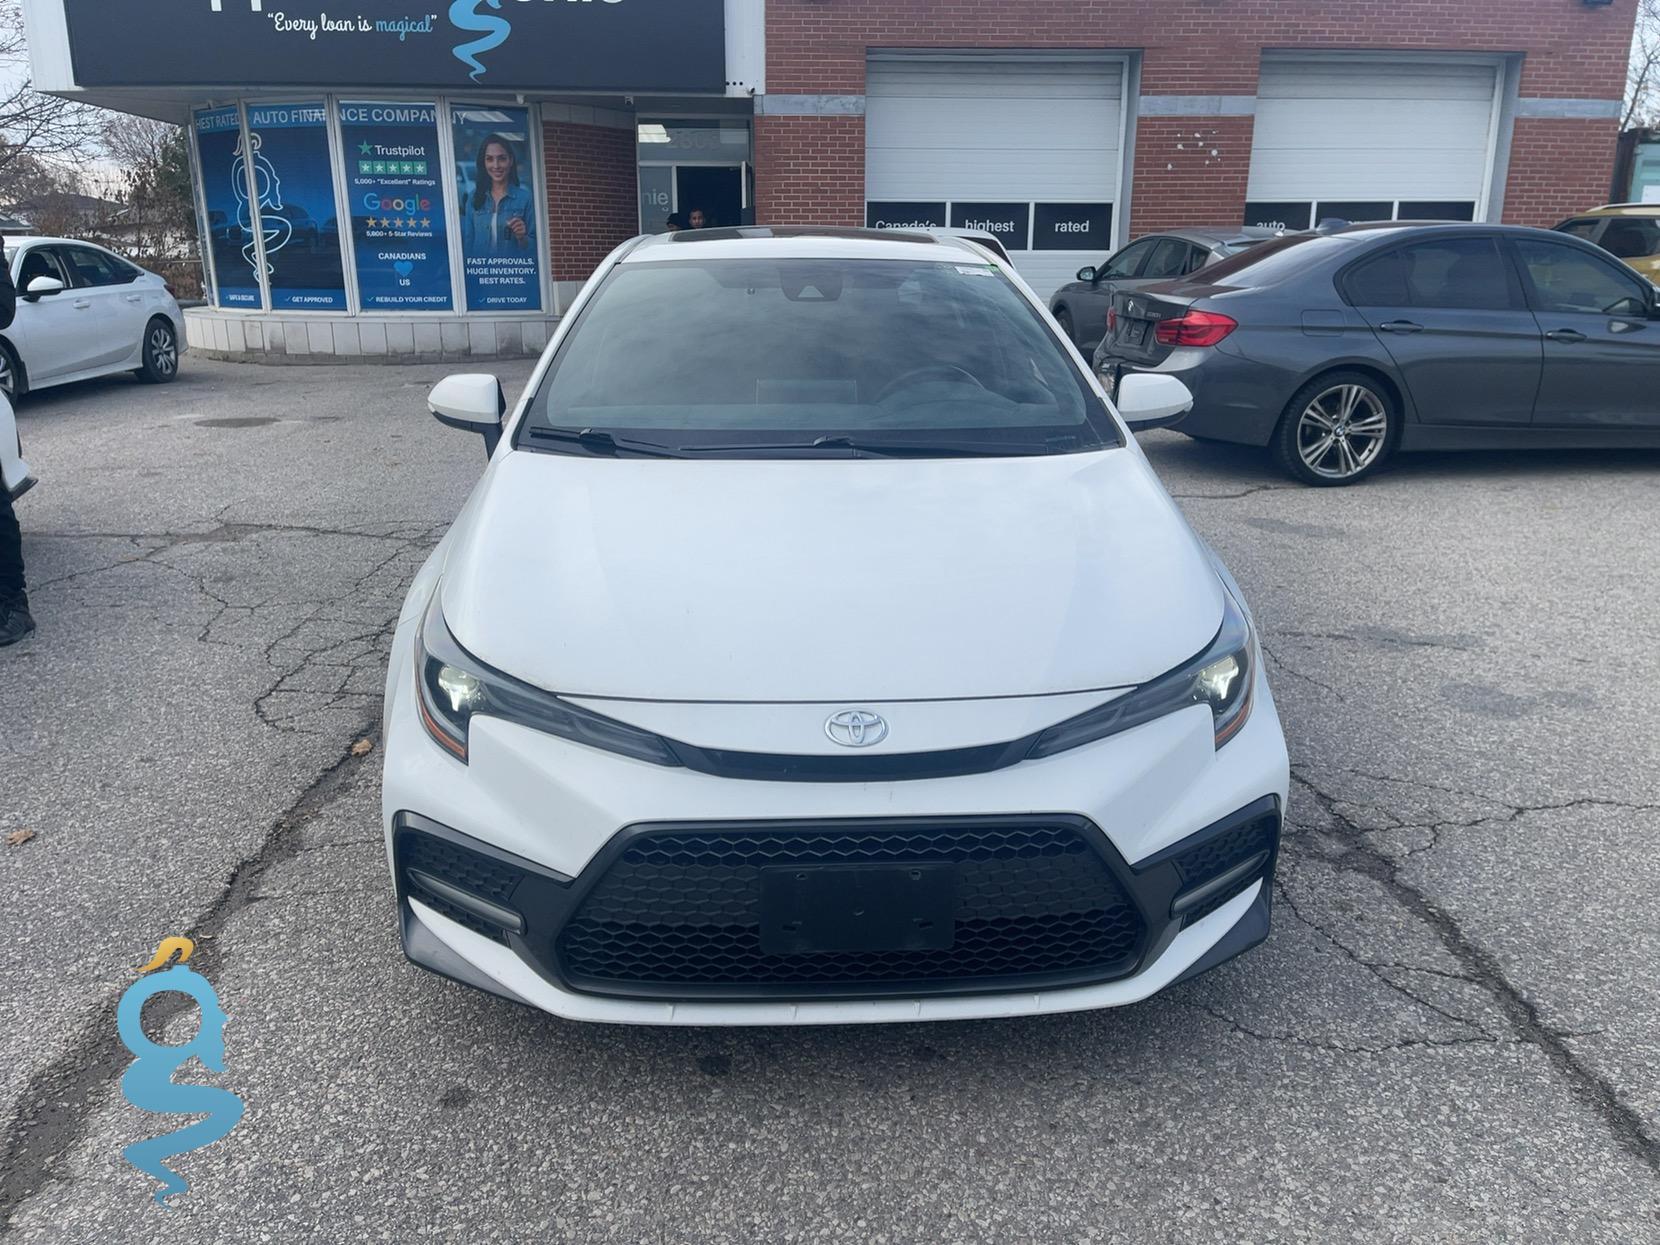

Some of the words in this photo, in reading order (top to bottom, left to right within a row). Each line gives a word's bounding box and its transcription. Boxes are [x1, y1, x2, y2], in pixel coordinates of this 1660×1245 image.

[321, 13, 355, 31] loan
[357, 15, 372, 31] is
[253, 110, 288, 124] AUTO
[374, 144, 425, 157] Trustpilot
[412, 178, 435, 186] Ratings
[363, 193, 431, 215] Google
[964, 219, 1015, 232] highest
[1054, 220, 1090, 233] rated
[378, 252, 426, 260] CANADIANS
[467, 257, 486, 265] FAST
[487, 257, 535, 265] APPROVALS.
[466, 267, 489, 275] HUGE
[489, 267, 537, 275] INVENTORY.
[399, 278, 411, 286] US
[291, 295, 303, 303] GET
[303, 296, 334, 304] APPROVED
[486, 296, 506, 304] DRIVE
